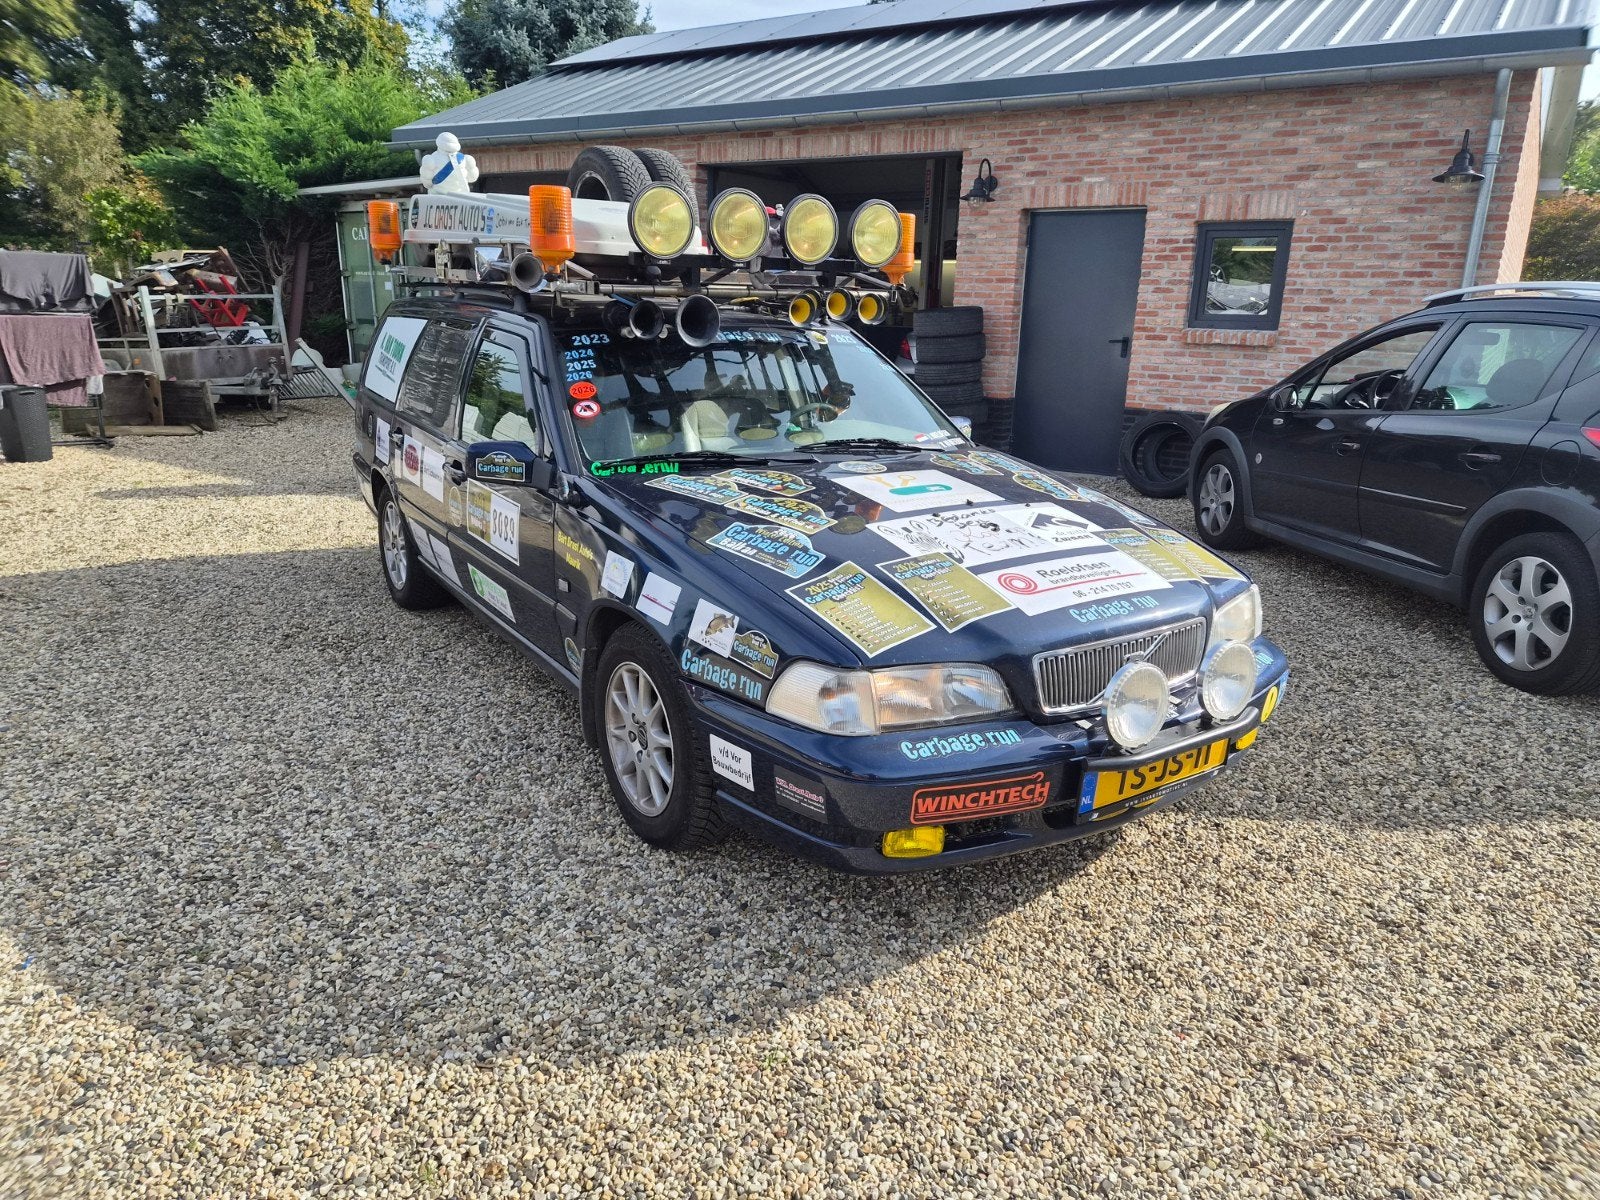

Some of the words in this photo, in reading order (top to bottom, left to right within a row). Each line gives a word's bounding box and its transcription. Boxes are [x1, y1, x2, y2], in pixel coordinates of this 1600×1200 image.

[434, 205, 459, 230] DROST
[458, 205, 487, 232] AUTO'S
[571, 333, 610, 346] 2023
[564, 348, 594, 360] 2024
[566, 359, 597, 372] 2025
[566, 370, 593, 382] 2026
[571, 385, 595, 395] 2026
[478, 463, 509, 473] Carbage
[511, 465, 523, 474] run
[744, 497, 803, 518] Carbage
[803, 514, 830, 526] run
[492, 508, 516, 545] 8089
[719, 538, 758, 556] Balkan
[725, 525, 790, 555] Carbage
[790, 549, 819, 567] run
[894, 564, 937, 581] Carbage
[937, 560, 954, 570] run
[1035, 560, 1110, 579] Roelofsen
[1050, 568, 1122, 585] brandbeveiliging
[804, 583, 848, 604] Carbage
[847, 573, 866, 586] run
[805, 580, 834, 596] 2025
[1072, 590, 1087, 598] 06
[1092, 586, 1108, 596] 214
[1069, 598, 1135, 623] Carbage
[1131, 594, 1160, 609] run
[733, 640, 762, 661] Carbage
[763, 655, 775, 667] run
[681, 648, 737, 689] Carbage
[739, 675, 763, 700] run
[900, 732, 986, 760] Carbage
[985, 728, 1022, 746] run
[718, 746, 729, 758] v/d
[730, 750, 742, 764] Vor
[712, 755, 752, 783] Bouwbedrijf
[917, 781, 1051, 814] WINCHTECH
[1081, 796, 1092, 805] NL
